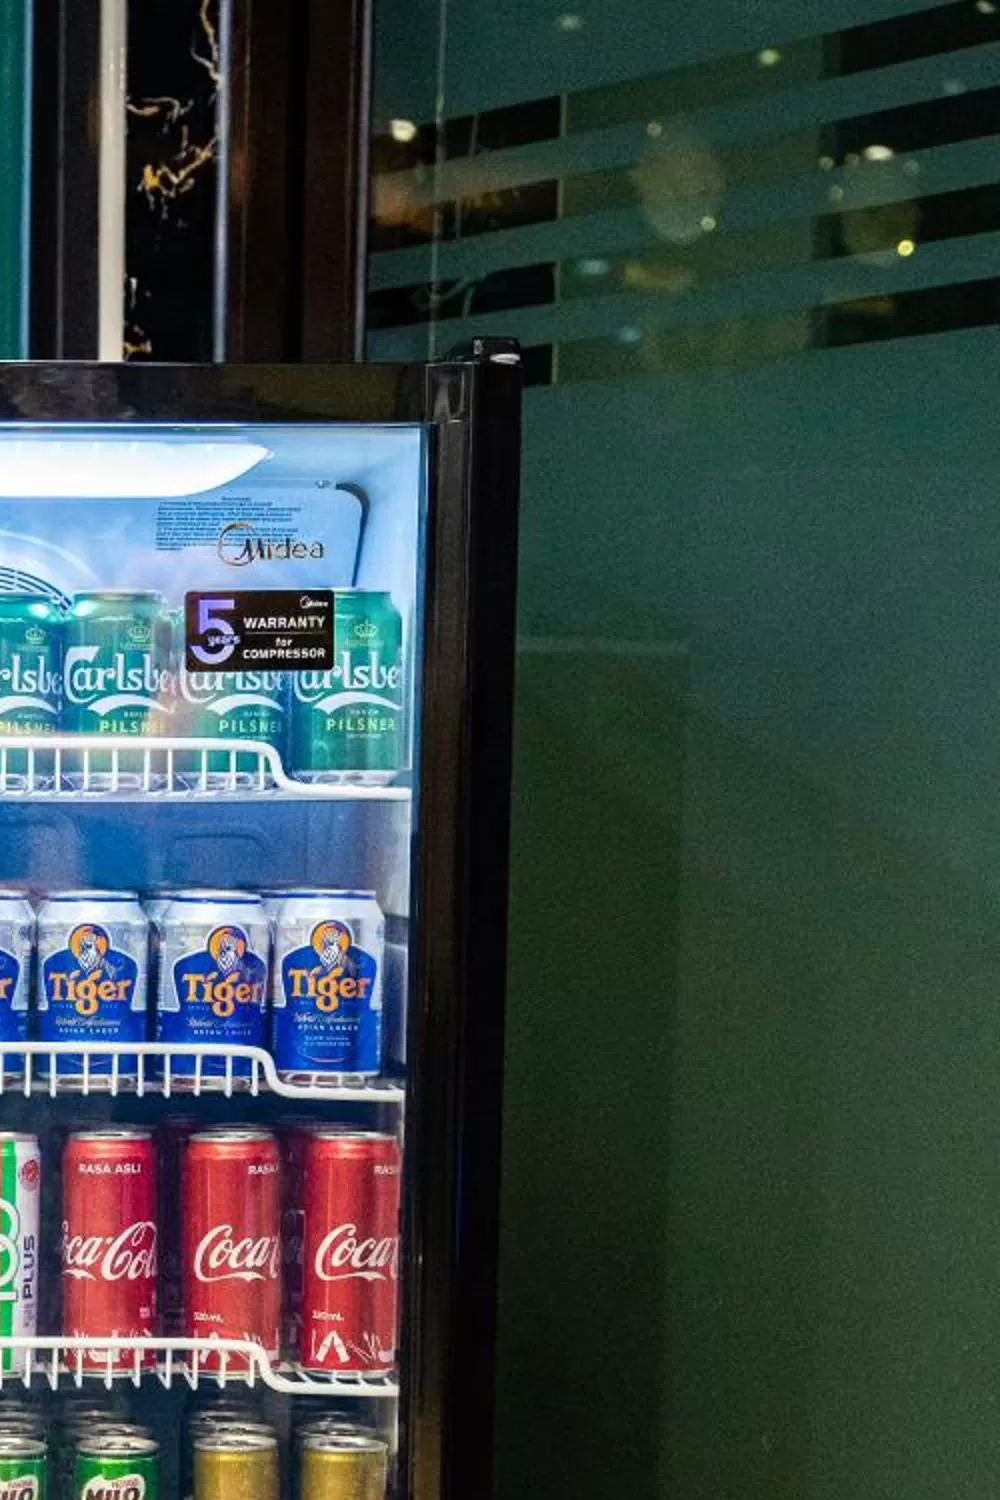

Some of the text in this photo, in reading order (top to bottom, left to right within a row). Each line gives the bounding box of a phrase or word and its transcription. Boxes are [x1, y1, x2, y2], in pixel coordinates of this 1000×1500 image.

[218, 521, 325, 566] Midea
[190, 598, 236, 665] 5
[207, 634, 241, 647] years
[243, 615, 327, 629] WARRANTY
[275, 636, 293, 647] for
[63, 645, 177, 704] Carlsbe
[242, 647, 327, 660] COMPRESSOR
[293, 651, 402, 703] Carlsbe
[48, 968, 132, 1015] Tiger
[182, 971, 264, 1017] Tiger
[287, 965, 371, 1013] Tiger
[78, 1163, 142, 1175] RASA ASLI
[22, 1235, 36, 1296] PLUS
